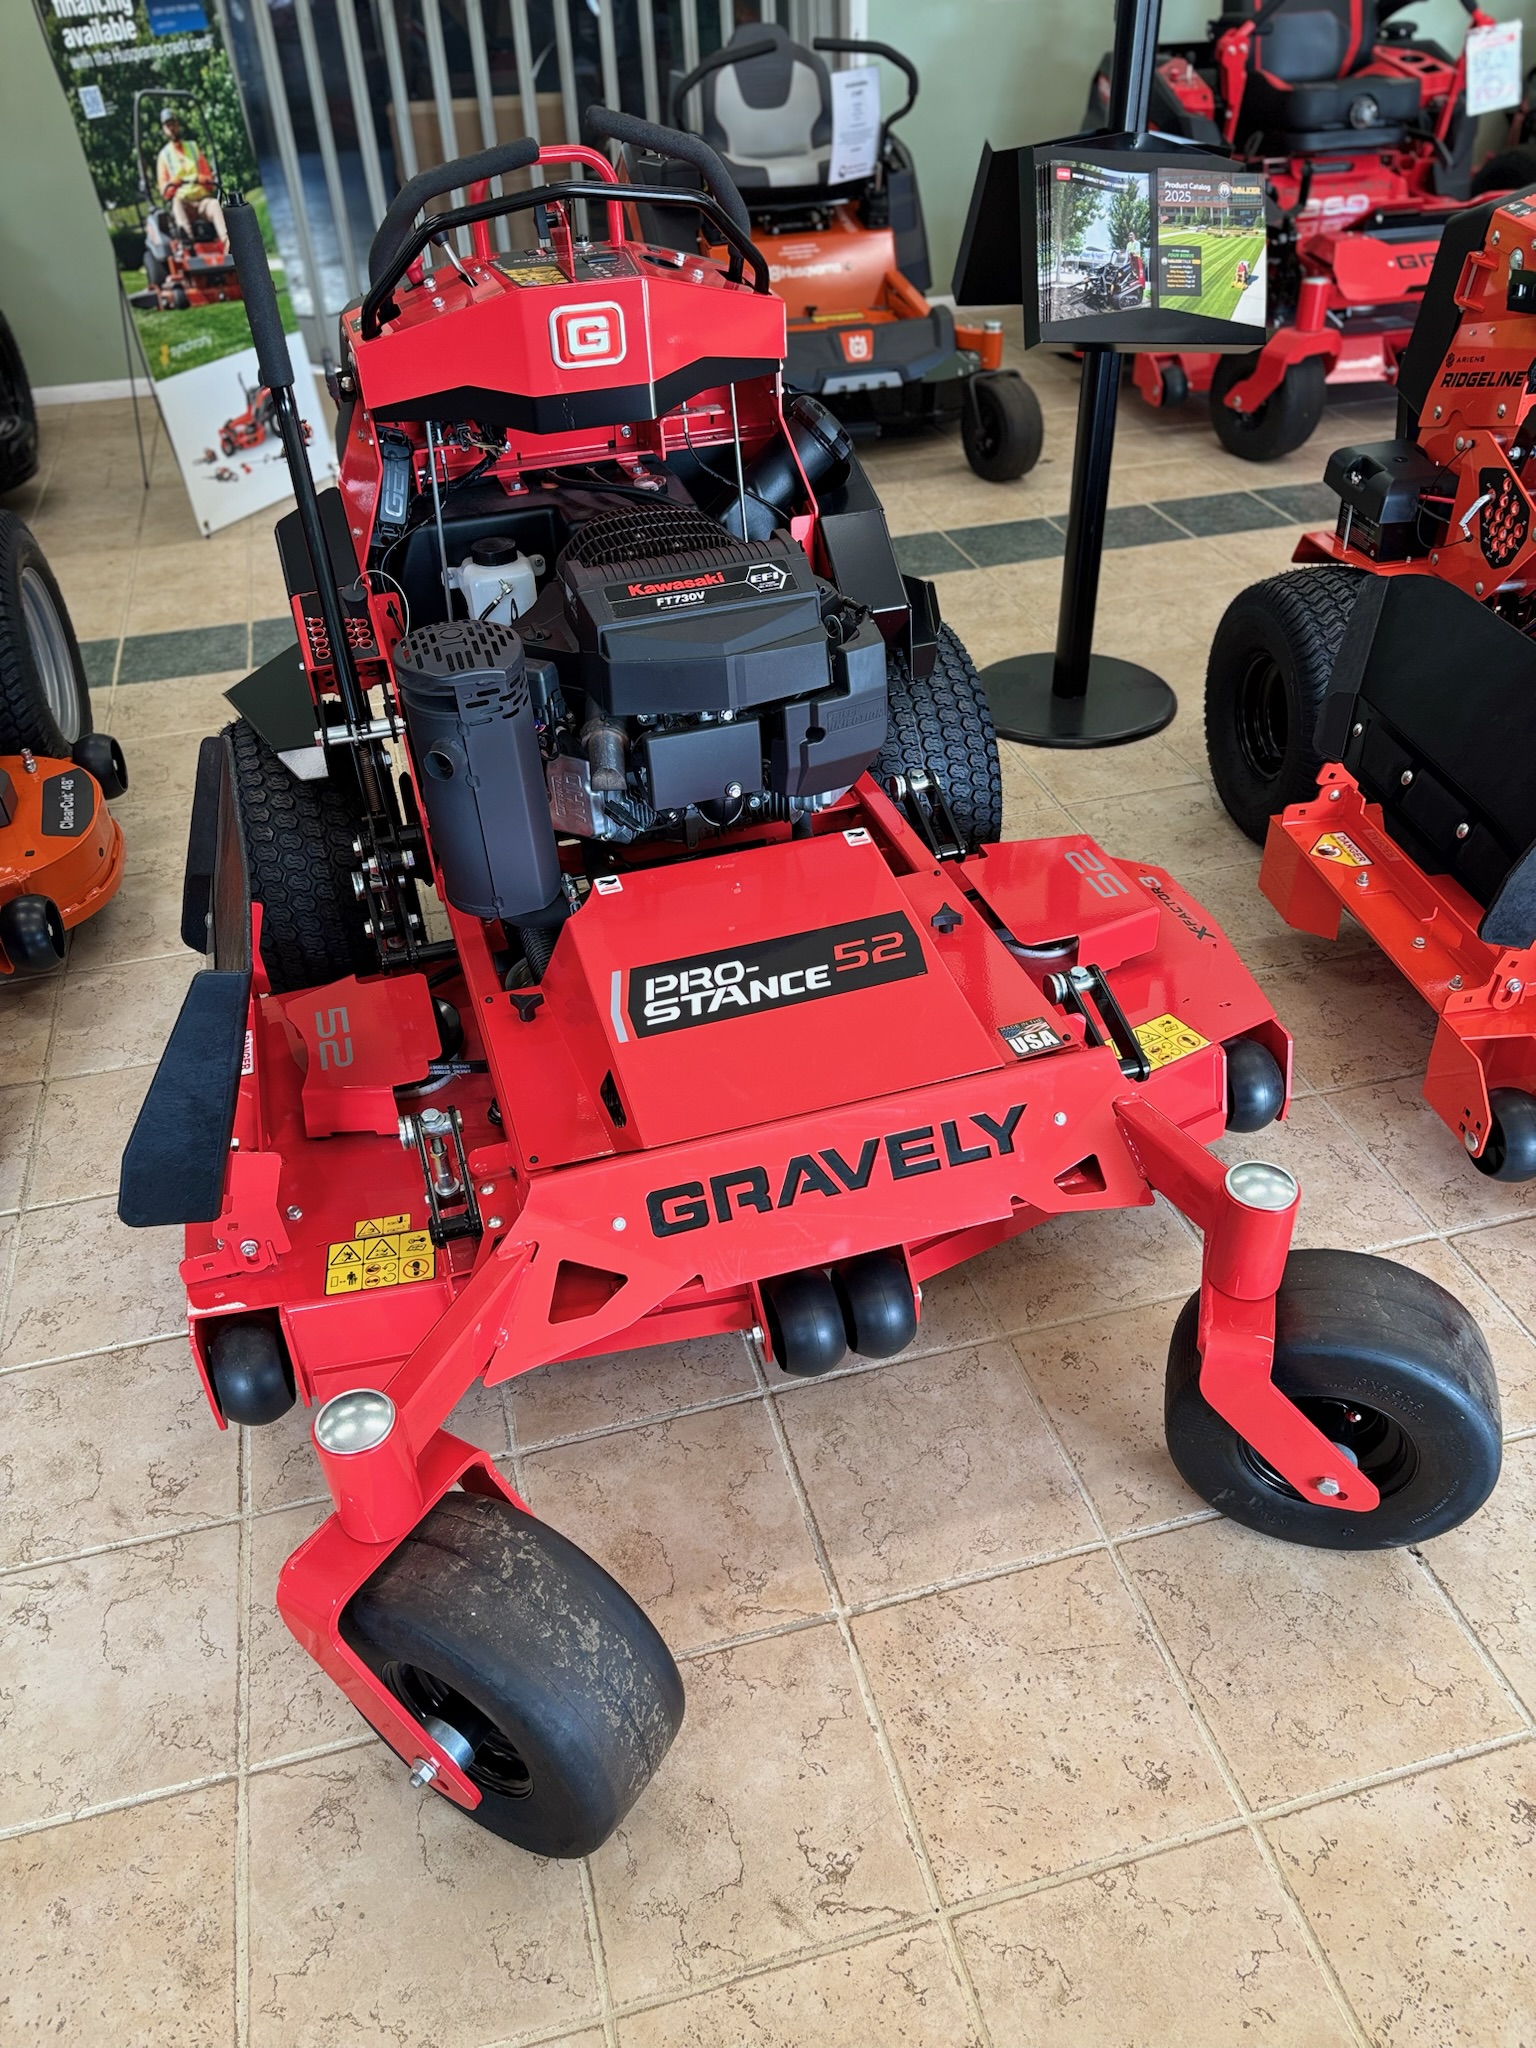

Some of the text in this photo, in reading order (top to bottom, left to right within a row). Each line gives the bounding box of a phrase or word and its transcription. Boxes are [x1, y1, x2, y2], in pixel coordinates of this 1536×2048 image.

[62, 16, 138, 49] available
[69, 55, 95, 70] with
[94, 51, 113, 67] the
[113, 44, 164, 63] Husqvarna
[164, 38, 189, 56] credit
[1164, 181, 1211, 192] Product Catalog
[1164, 190, 1191, 203] 2025
[1230, 186, 1261, 195] WALKER
[782, 262, 842, 279] Husqvarna
[1456, 355, 1486, 363] ARIENS
[1440, 371, 1528, 388] RIDGELINE
[627, 571, 726, 597] Kawasaki
[750, 571, 779, 584] EFI
[656, 591, 705, 607] FT730V
[1337, 835, 1367, 862] DANGER
[1064, 849, 1130, 898] 52
[833, 931, 907, 972] 52
[645, 960, 760, 1002] PRO-
[643, 964, 832, 1026] STANCE
[315, 1006, 354, 1071] 52
[1000, 1023, 1018, 1031] MADE
[1008, 1029, 1060, 1053] USA
[646, 1103, 1028, 1238] GRAVELY
